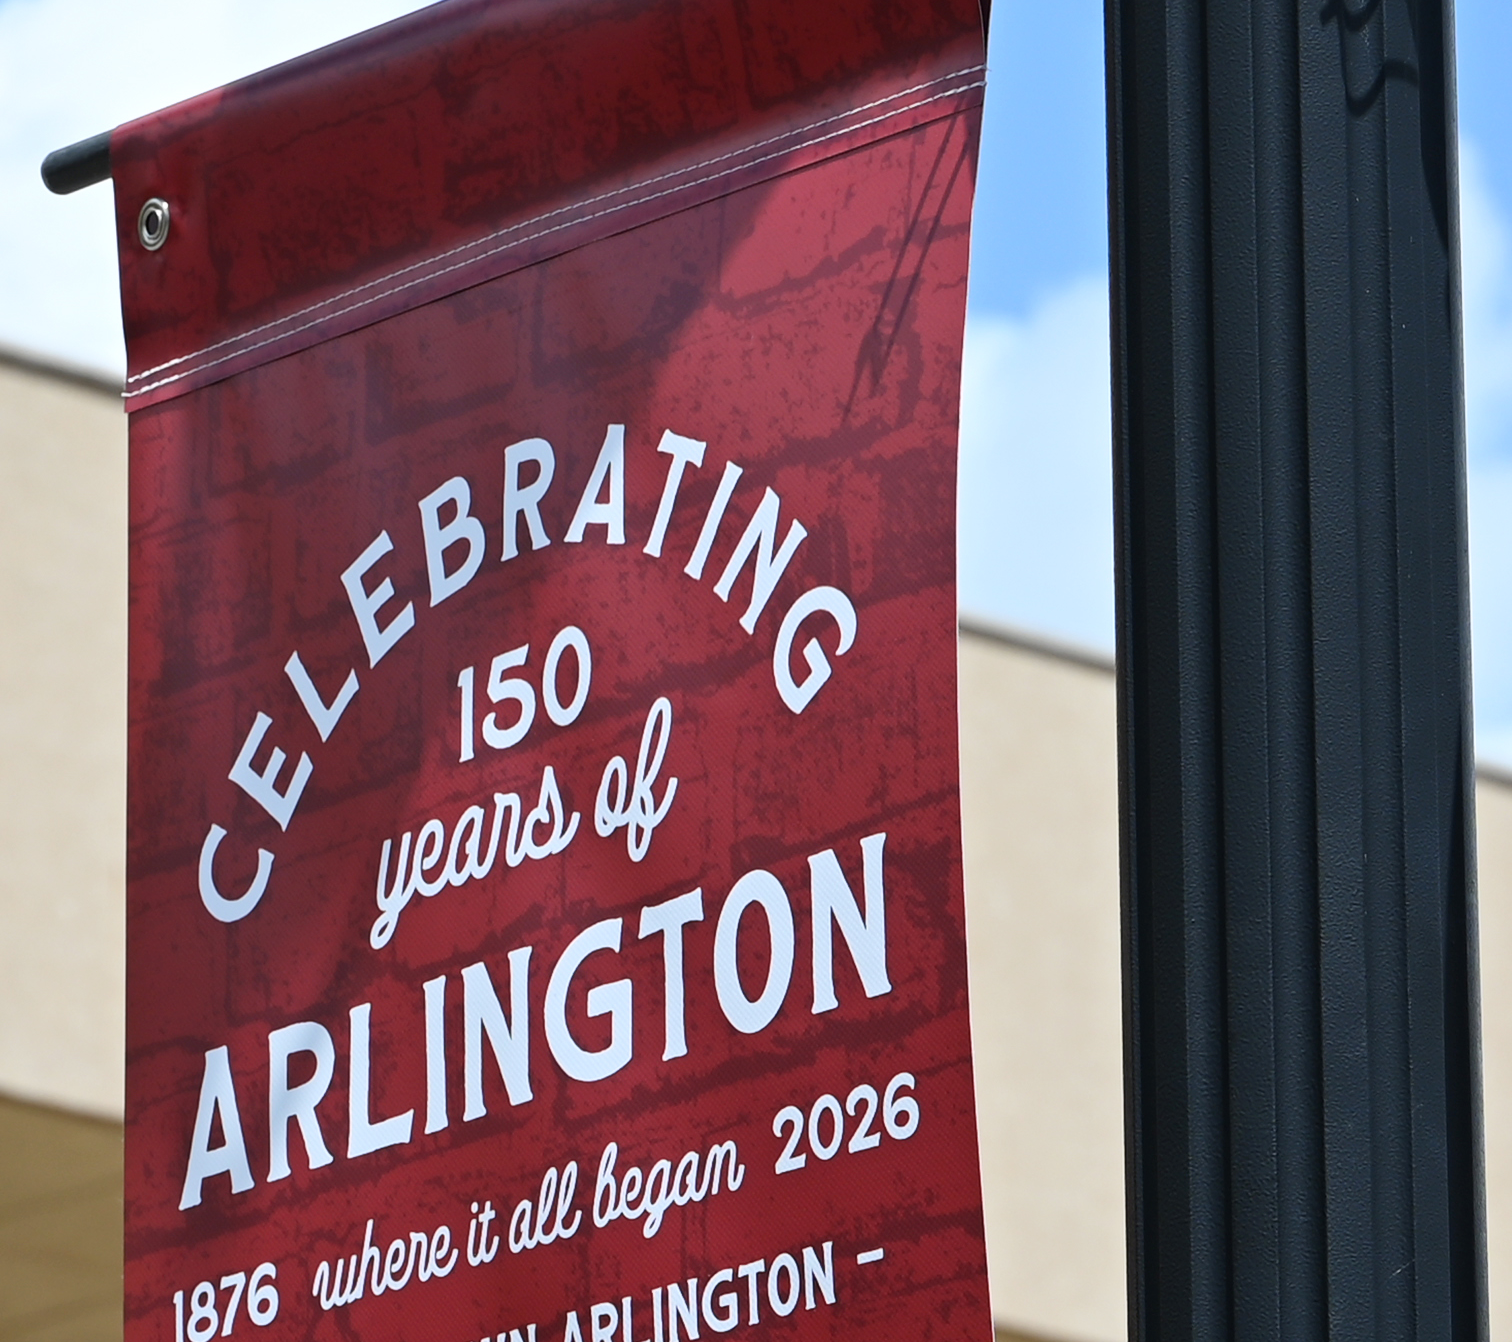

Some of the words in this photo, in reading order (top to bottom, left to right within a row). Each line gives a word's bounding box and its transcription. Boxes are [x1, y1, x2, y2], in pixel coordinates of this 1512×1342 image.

[198, 423, 857, 923] CELEBRATING
[457, 625, 592, 763] 150
[369, 765, 581, 950] years
[595, 696, 678, 863] of
[178, 832, 892, 1211] ARLINGTON
[312, 1218, 459, 1312] where
[466, 1201, 500, 1267] it
[508, 1160, 583, 1252] all
[592, 1140, 745, 1239] began
[772, 1072, 920, 1175] 2026
